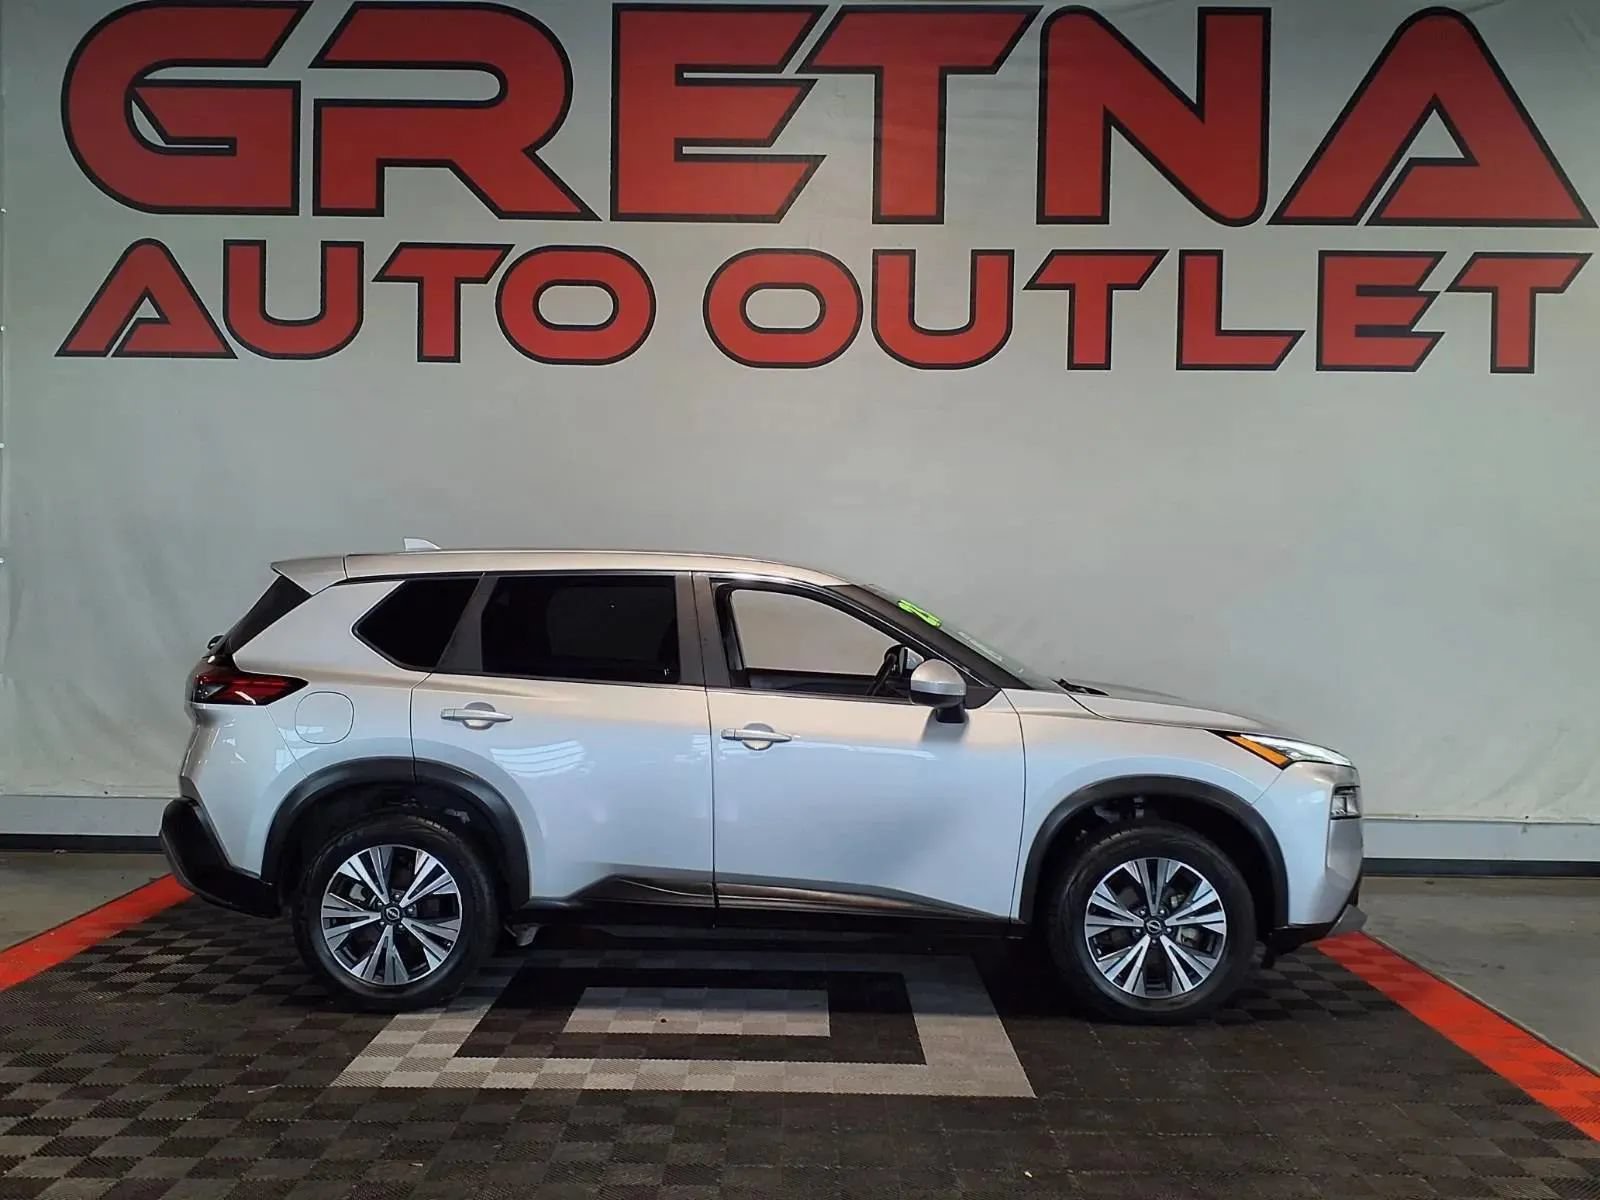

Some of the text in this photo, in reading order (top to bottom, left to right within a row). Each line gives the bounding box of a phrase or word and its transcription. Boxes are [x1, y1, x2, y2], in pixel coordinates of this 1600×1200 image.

[61, 1, 1598, 228] GRETNA
[55, 238, 1592, 373] AUTO OUTLET
